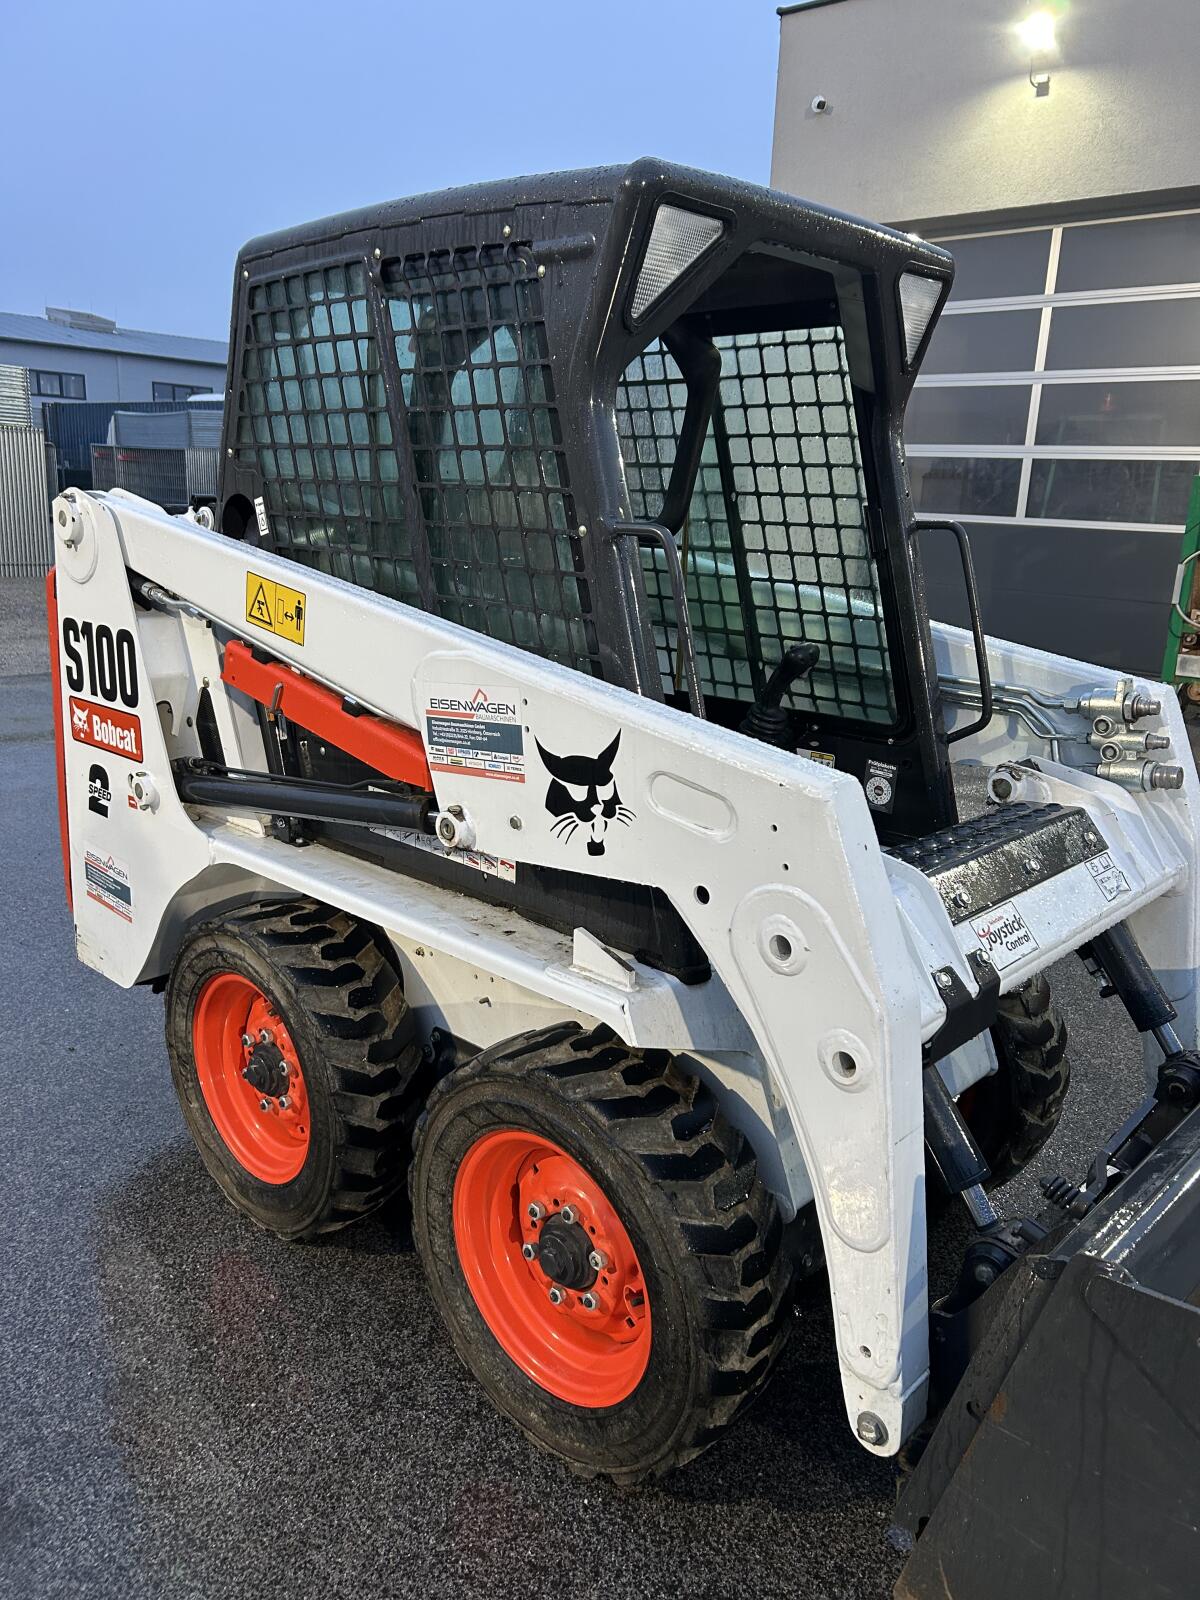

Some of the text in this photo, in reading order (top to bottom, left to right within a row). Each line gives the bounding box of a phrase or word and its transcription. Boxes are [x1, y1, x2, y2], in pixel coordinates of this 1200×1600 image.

[63, 617, 139, 708] S100
[430, 698, 516, 715] EISENWAGEN
[475, 714, 517, 723] BAUMASCHINEN
[92, 714, 137, 754] Bobcat
[88, 763, 110, 819] 2
[88, 783, 112, 802] SPEED
[1005, 930, 1031, 951] Control
